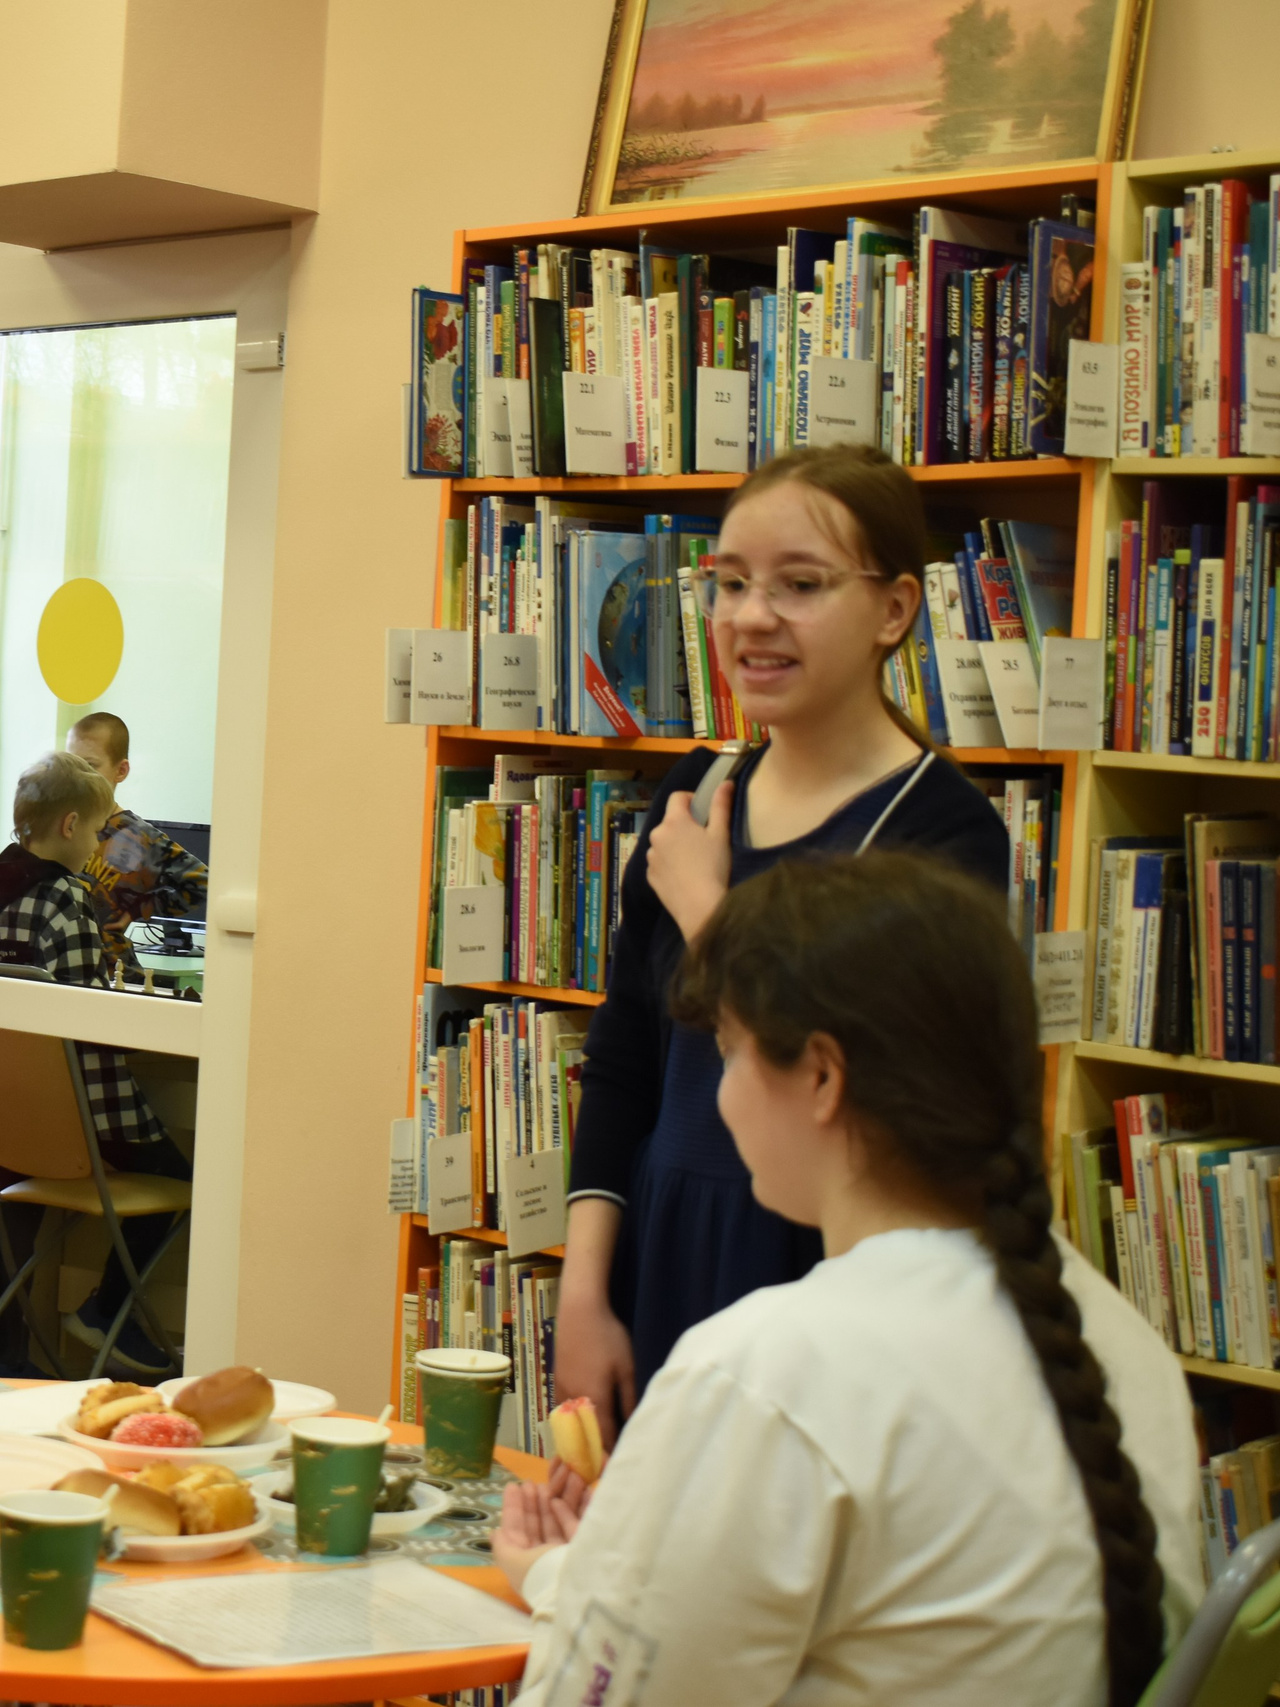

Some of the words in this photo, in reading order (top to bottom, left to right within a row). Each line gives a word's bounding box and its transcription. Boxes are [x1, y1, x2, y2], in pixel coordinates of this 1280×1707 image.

[834, 282, 842, 329] ФИЗИКА
[850, 274, 858, 328] МИКРОСКОП
[951, 285, 960, 336] ХОКИНГ
[973, 275, 985, 328] ХОКИНГ
[1017, 270, 1029, 324] ХОКИНГ
[1125, 304, 1141, 342] МИР
[798, 328, 811, 365] МИР
[579, 382, 595, 395] 22.1
[828, 375, 846, 388] 22.6
[970, 340, 983, 415] ВСЕЛЕННОЙ
[994, 358, 1009, 415] ВЗРЫВ
[1124, 348, 1141, 423] ПОЗНАЮ
[714, 391, 731, 403] 22.3
[796, 370, 809, 440] ПОЗНАЮ
[575, 427, 612, 438] Математика
[715, 438, 739, 448] Физика
[1123, 428, 1139, 442] Я
[432, 651, 443, 663] 26
[503, 655, 521, 667] 26.8
[1002, 659, 1019, 671] 28.5
[1200, 635, 1212, 686] ФОКУСОВ
[417, 690, 439, 700] Науки
[446, 691, 465, 700] Земле
[502, 700, 522, 708] науки
[1197, 706, 1210, 737] 250
[1014, 842, 1022, 884] БИОНИКА
[460, 904, 476, 915] 28.6
[444, 1156, 454, 1167] 39
[1114, 1211, 1127, 1256] КАРЮХА
